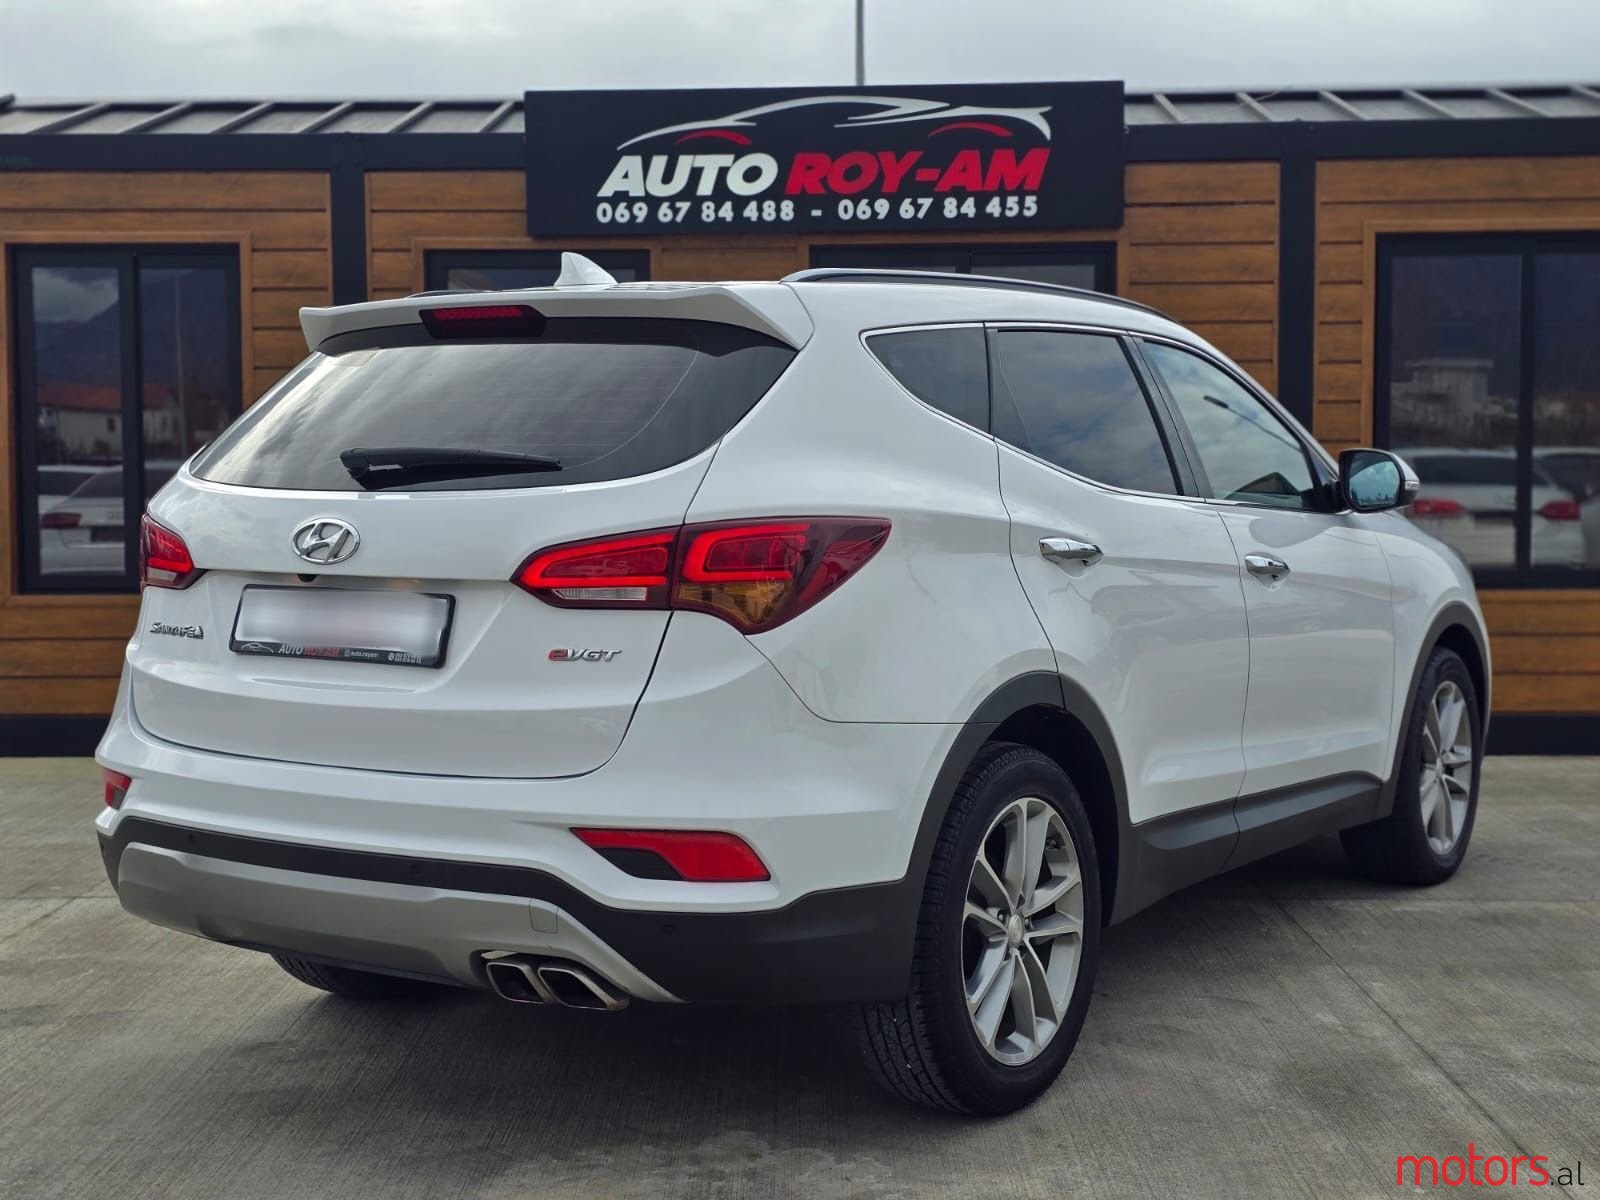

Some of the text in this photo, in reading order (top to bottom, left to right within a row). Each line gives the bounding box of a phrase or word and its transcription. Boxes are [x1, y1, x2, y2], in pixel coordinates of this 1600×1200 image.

[596, 147, 1050, 197] AUTO ROY-AM
[596, 201, 648, 223] 069
[657, 201, 691, 223] 67
[701, 200, 734, 222] 84
[742, 200, 795, 221] 488
[837, 198, 890, 220] 069
[899, 198, 933, 219] 67
[943, 197, 976, 218] 84
[985, 195, 1038, 217] 455
[278, 644, 304, 655] AUTO
[547, 648, 622, 662] eVGT
